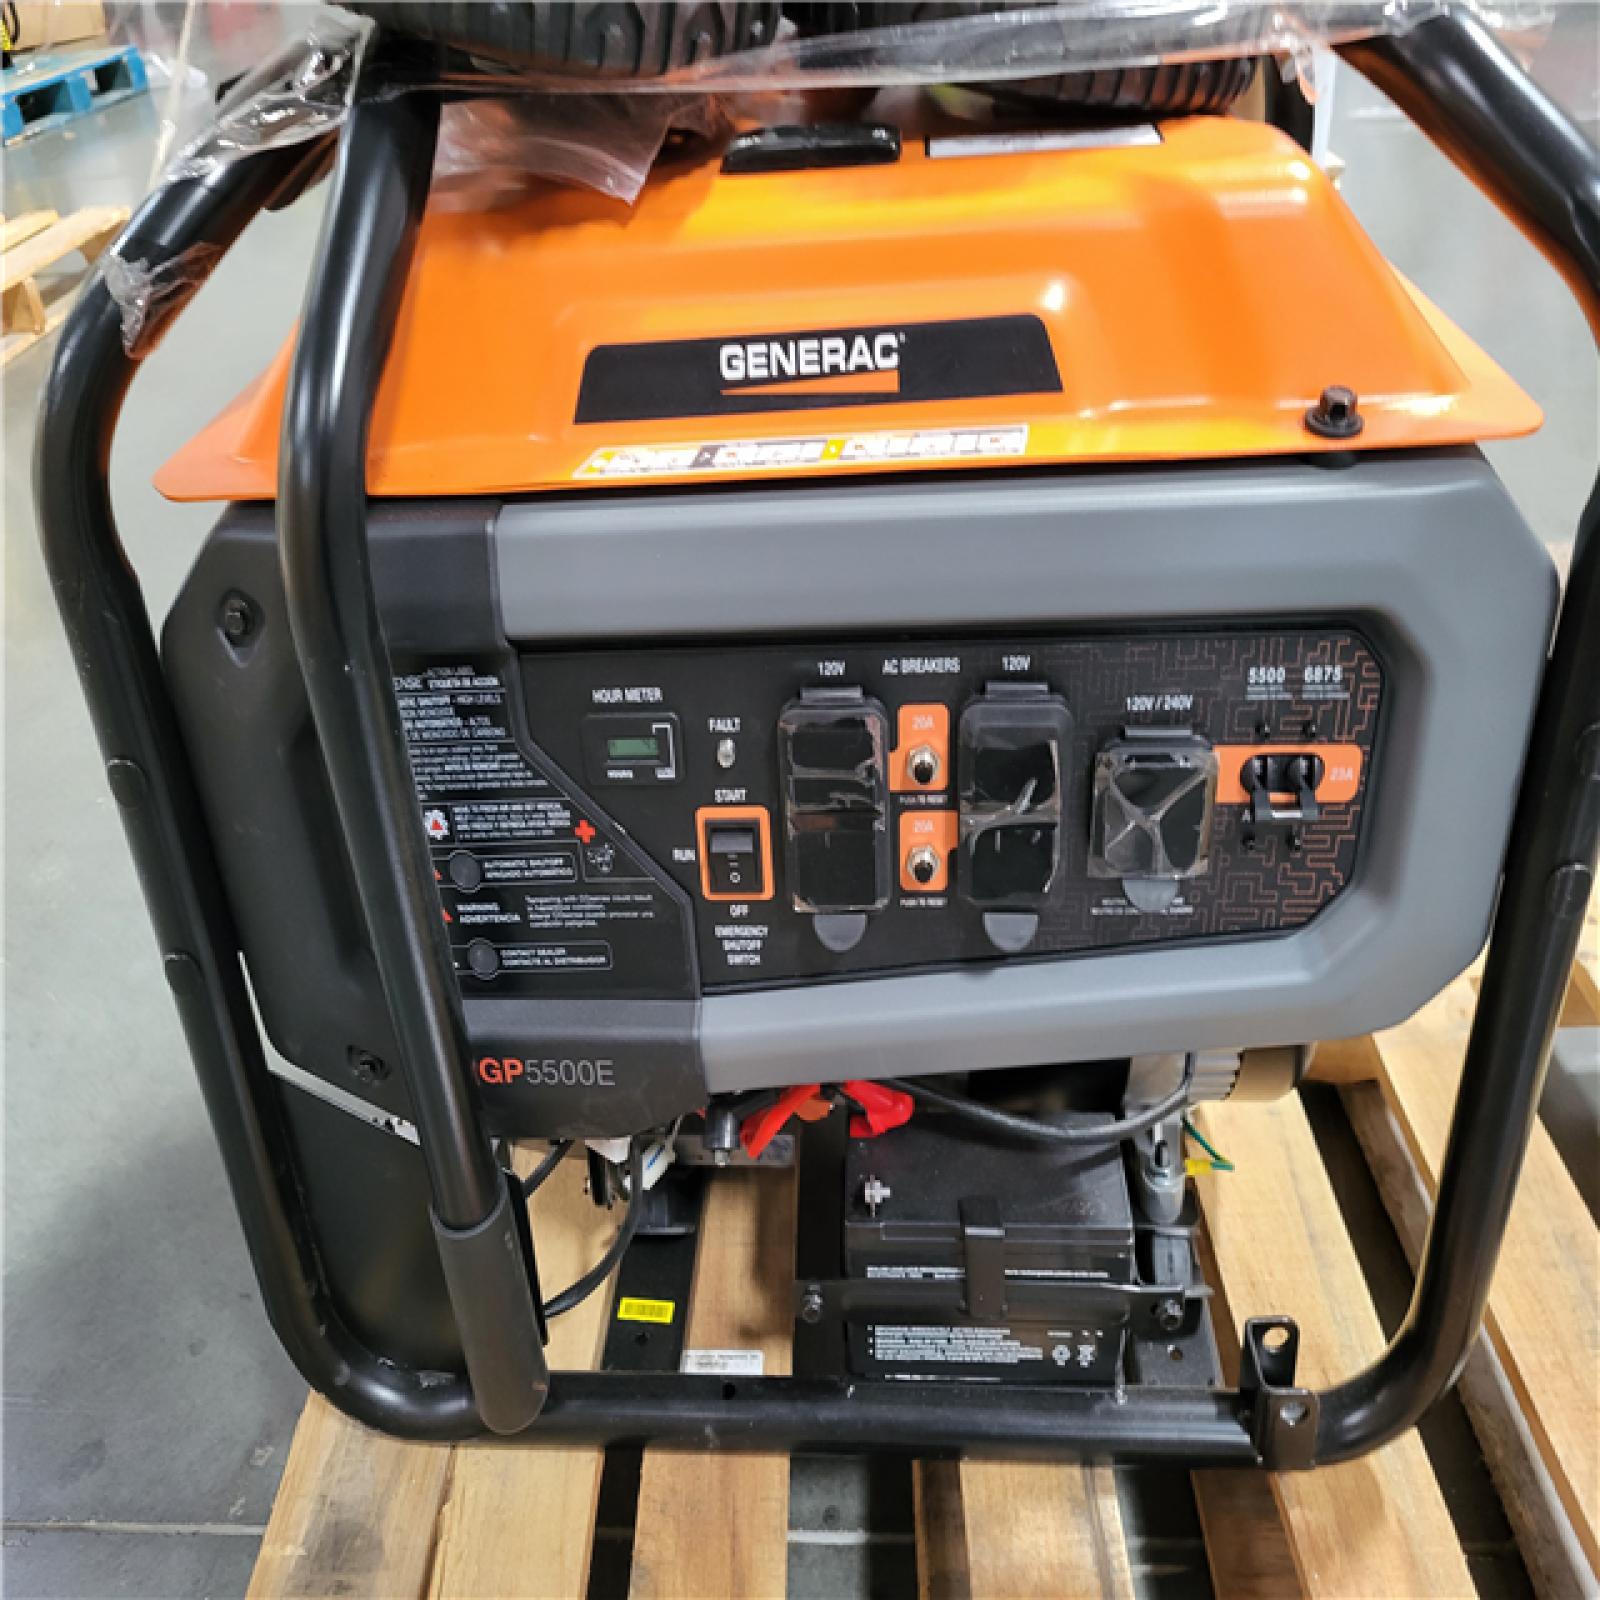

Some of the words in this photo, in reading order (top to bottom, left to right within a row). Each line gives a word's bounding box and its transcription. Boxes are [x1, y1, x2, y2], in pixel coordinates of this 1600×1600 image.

[719, 332, 900, 381] GENERAC
[817, 660, 846, 676] 120V
[900, 656, 961, 674] BREAKERS
[1001, 654, 1031, 671] 120V
[592, 688, 623, 703] HOUR
[624, 686, 663, 702] METER
[708, 717, 741, 733] FAULT
[714, 788, 747, 803] START
[729, 904, 750, 918] OFF
[479, 1056, 616, 1086] GP5500E
